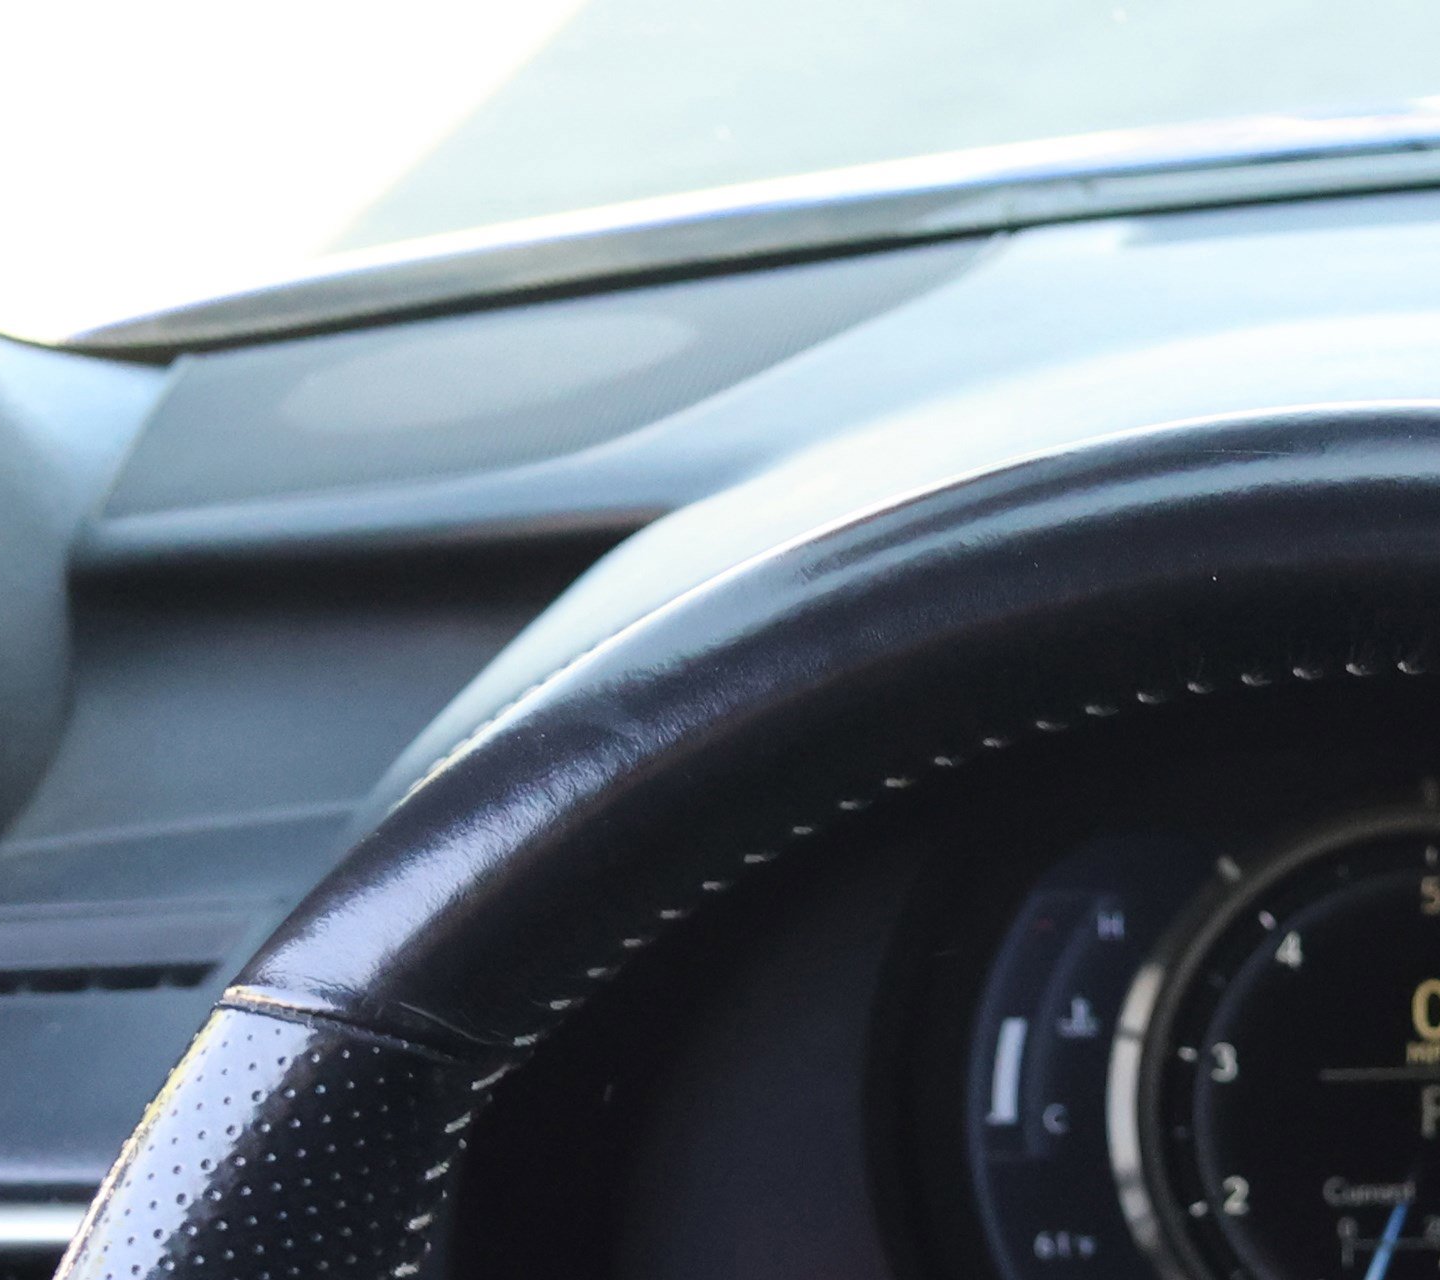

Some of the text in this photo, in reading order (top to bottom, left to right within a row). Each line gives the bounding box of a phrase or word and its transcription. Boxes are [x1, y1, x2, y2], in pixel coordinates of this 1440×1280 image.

[1275, 931, 1304, 968] 4
[1210, 1042, 1239, 1082] 3
[1221, 1175, 1250, 1217] 2
